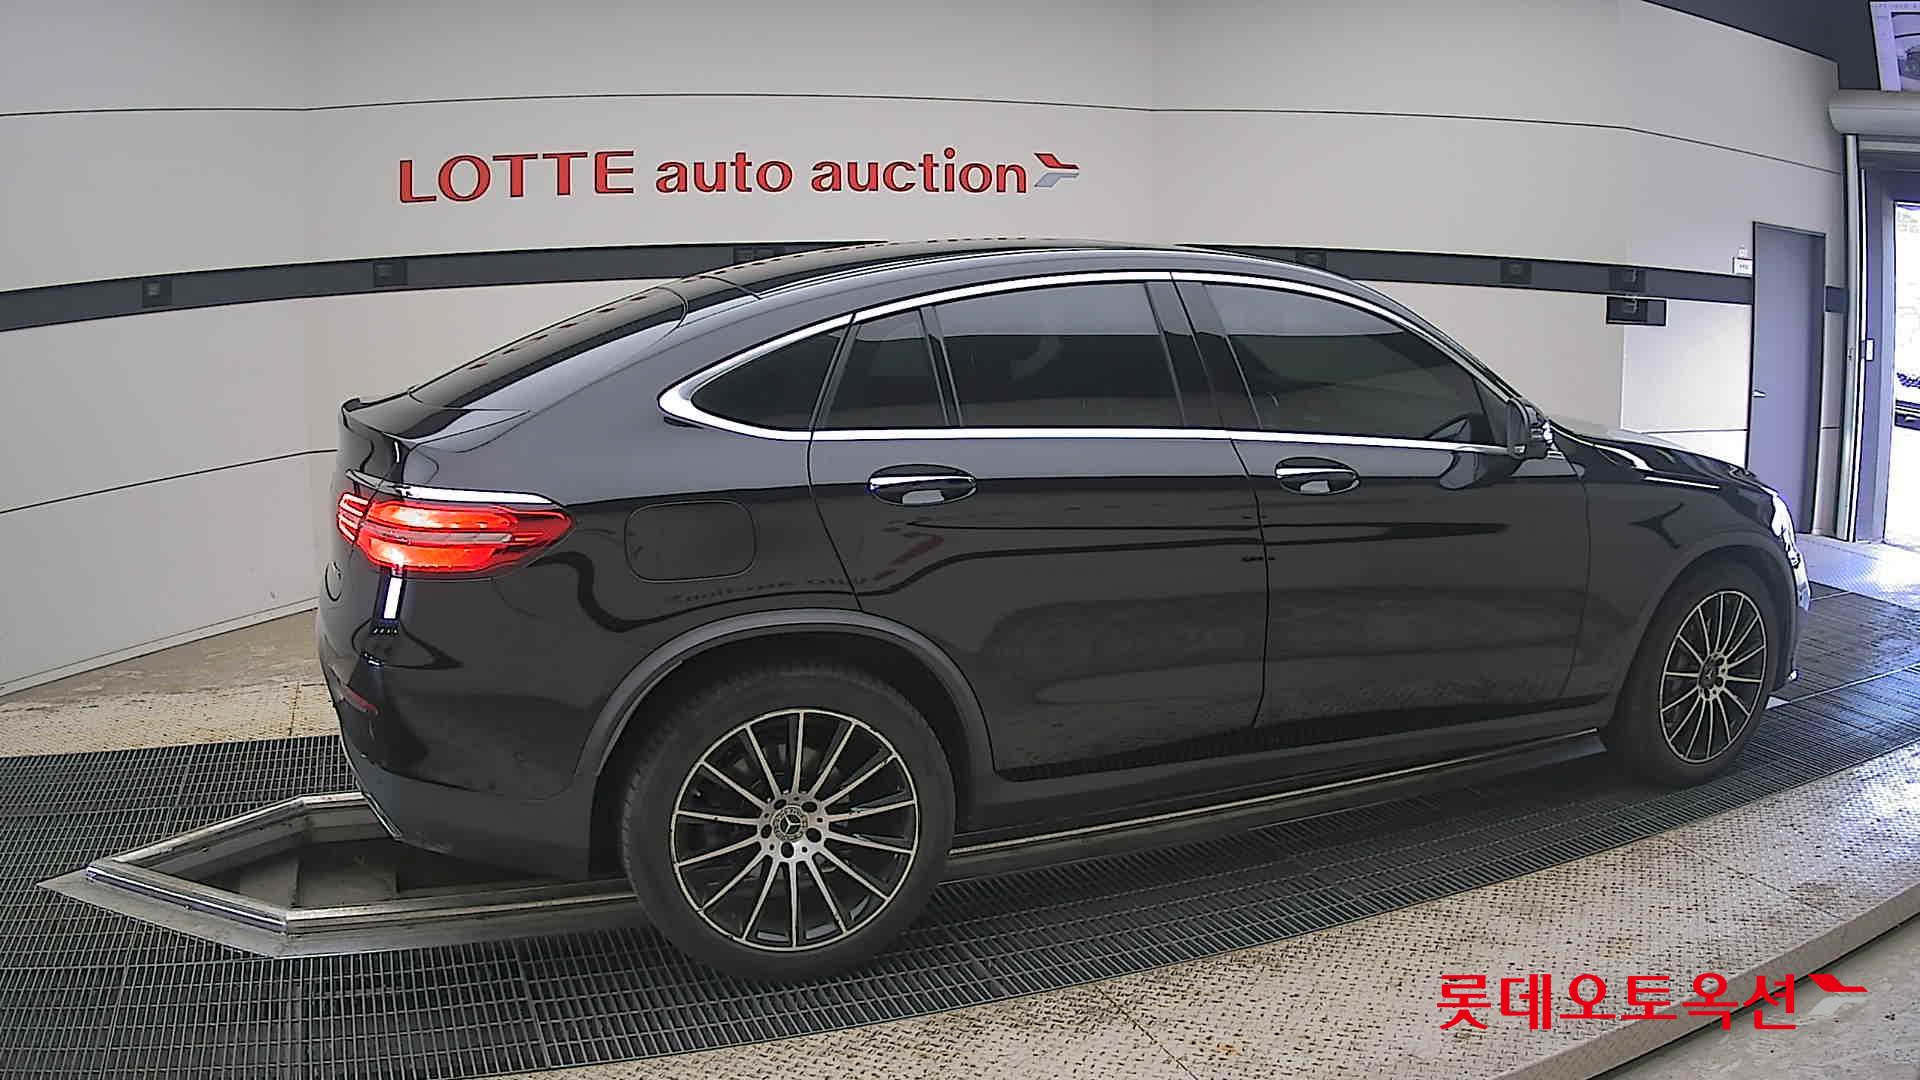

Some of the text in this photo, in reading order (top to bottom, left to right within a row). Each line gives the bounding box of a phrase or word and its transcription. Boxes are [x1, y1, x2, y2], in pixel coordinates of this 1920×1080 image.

[399, 147, 1027, 204] LOTTE auto auction
